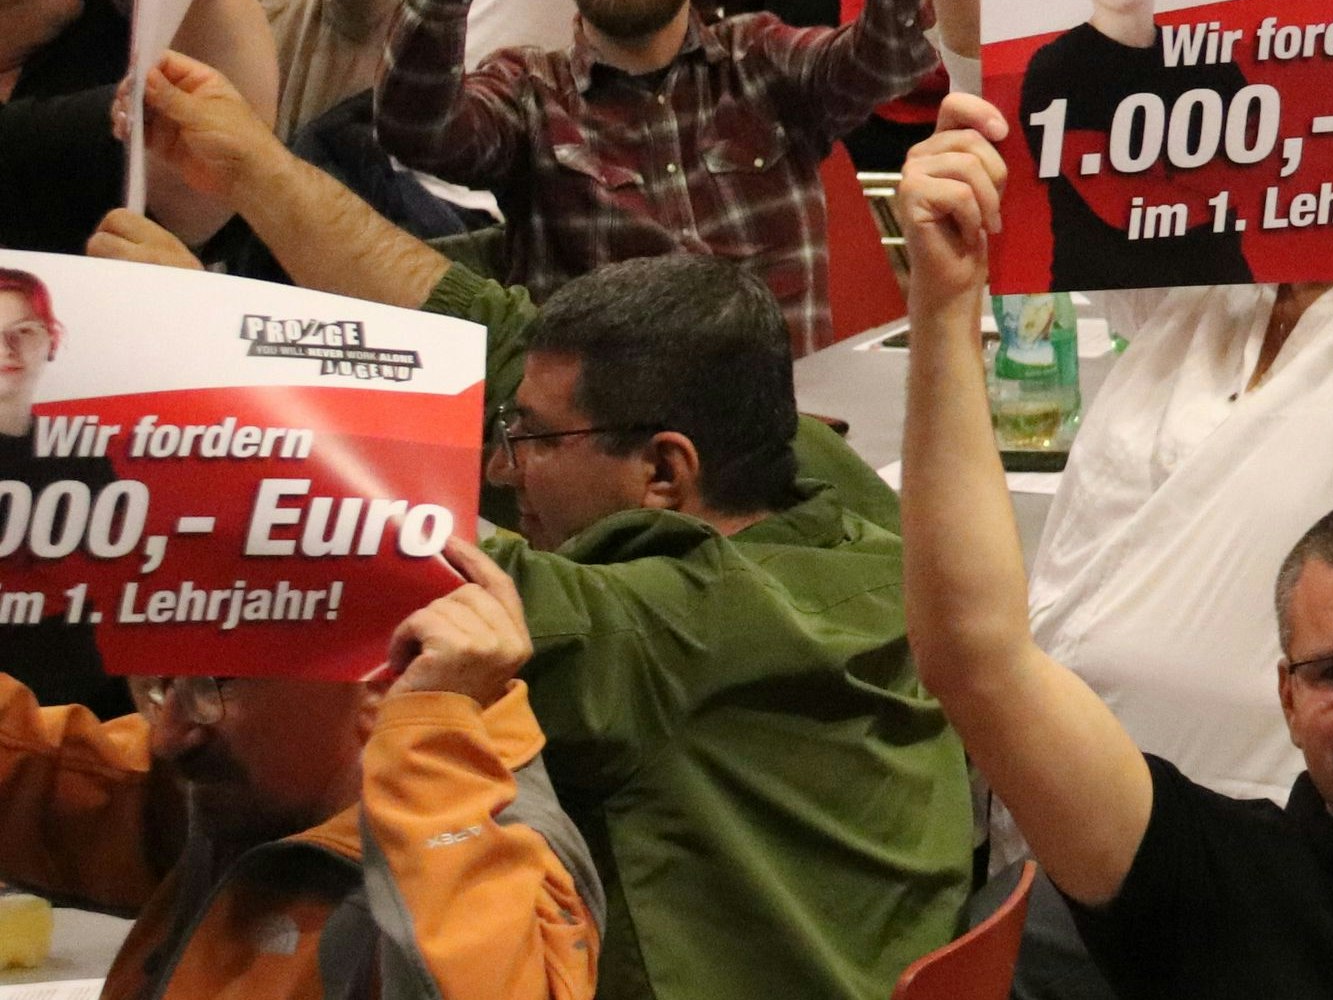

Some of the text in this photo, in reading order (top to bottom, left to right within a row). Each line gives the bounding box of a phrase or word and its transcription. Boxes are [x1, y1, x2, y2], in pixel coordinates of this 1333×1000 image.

[1161, 19, 1243, 68] Wir
[1128, 196, 1187, 240] im
[1207, 191, 1247, 234] 1.
[307, 348, 344, 358] NEVER
[379, 353, 415, 364] ALONE
[35, 415, 315, 459] Wir fordern
[243, 479, 454, 558] Euro
[64, 581, 344, 630] 1. Lehrjahr!
